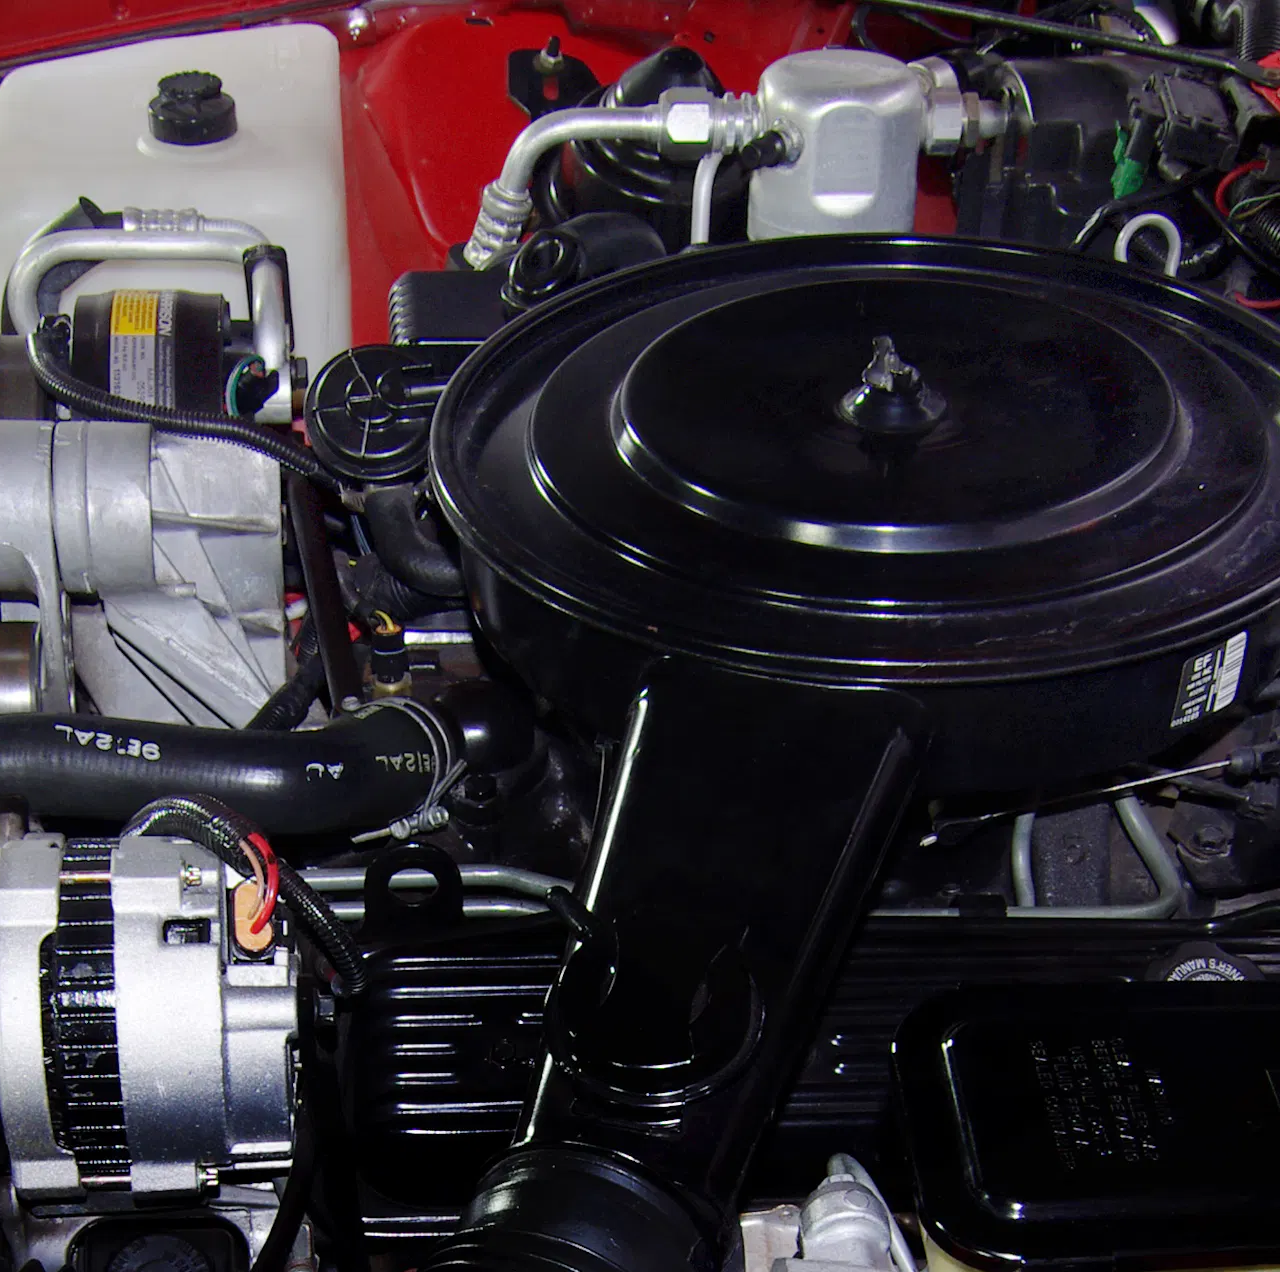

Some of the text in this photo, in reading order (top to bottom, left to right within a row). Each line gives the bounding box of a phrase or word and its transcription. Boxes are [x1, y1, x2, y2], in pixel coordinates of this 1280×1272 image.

[1193, 653, 1213, 673] EF
[1167, 958, 1206, 982] MANUA
[1027, 1040, 1054, 1089] SEALED
[1052, 1056, 1073, 1091] FLUID
[1090, 1039, 1120, 1089] BEFORE
[1124, 1084, 1148, 1129] FILLER
